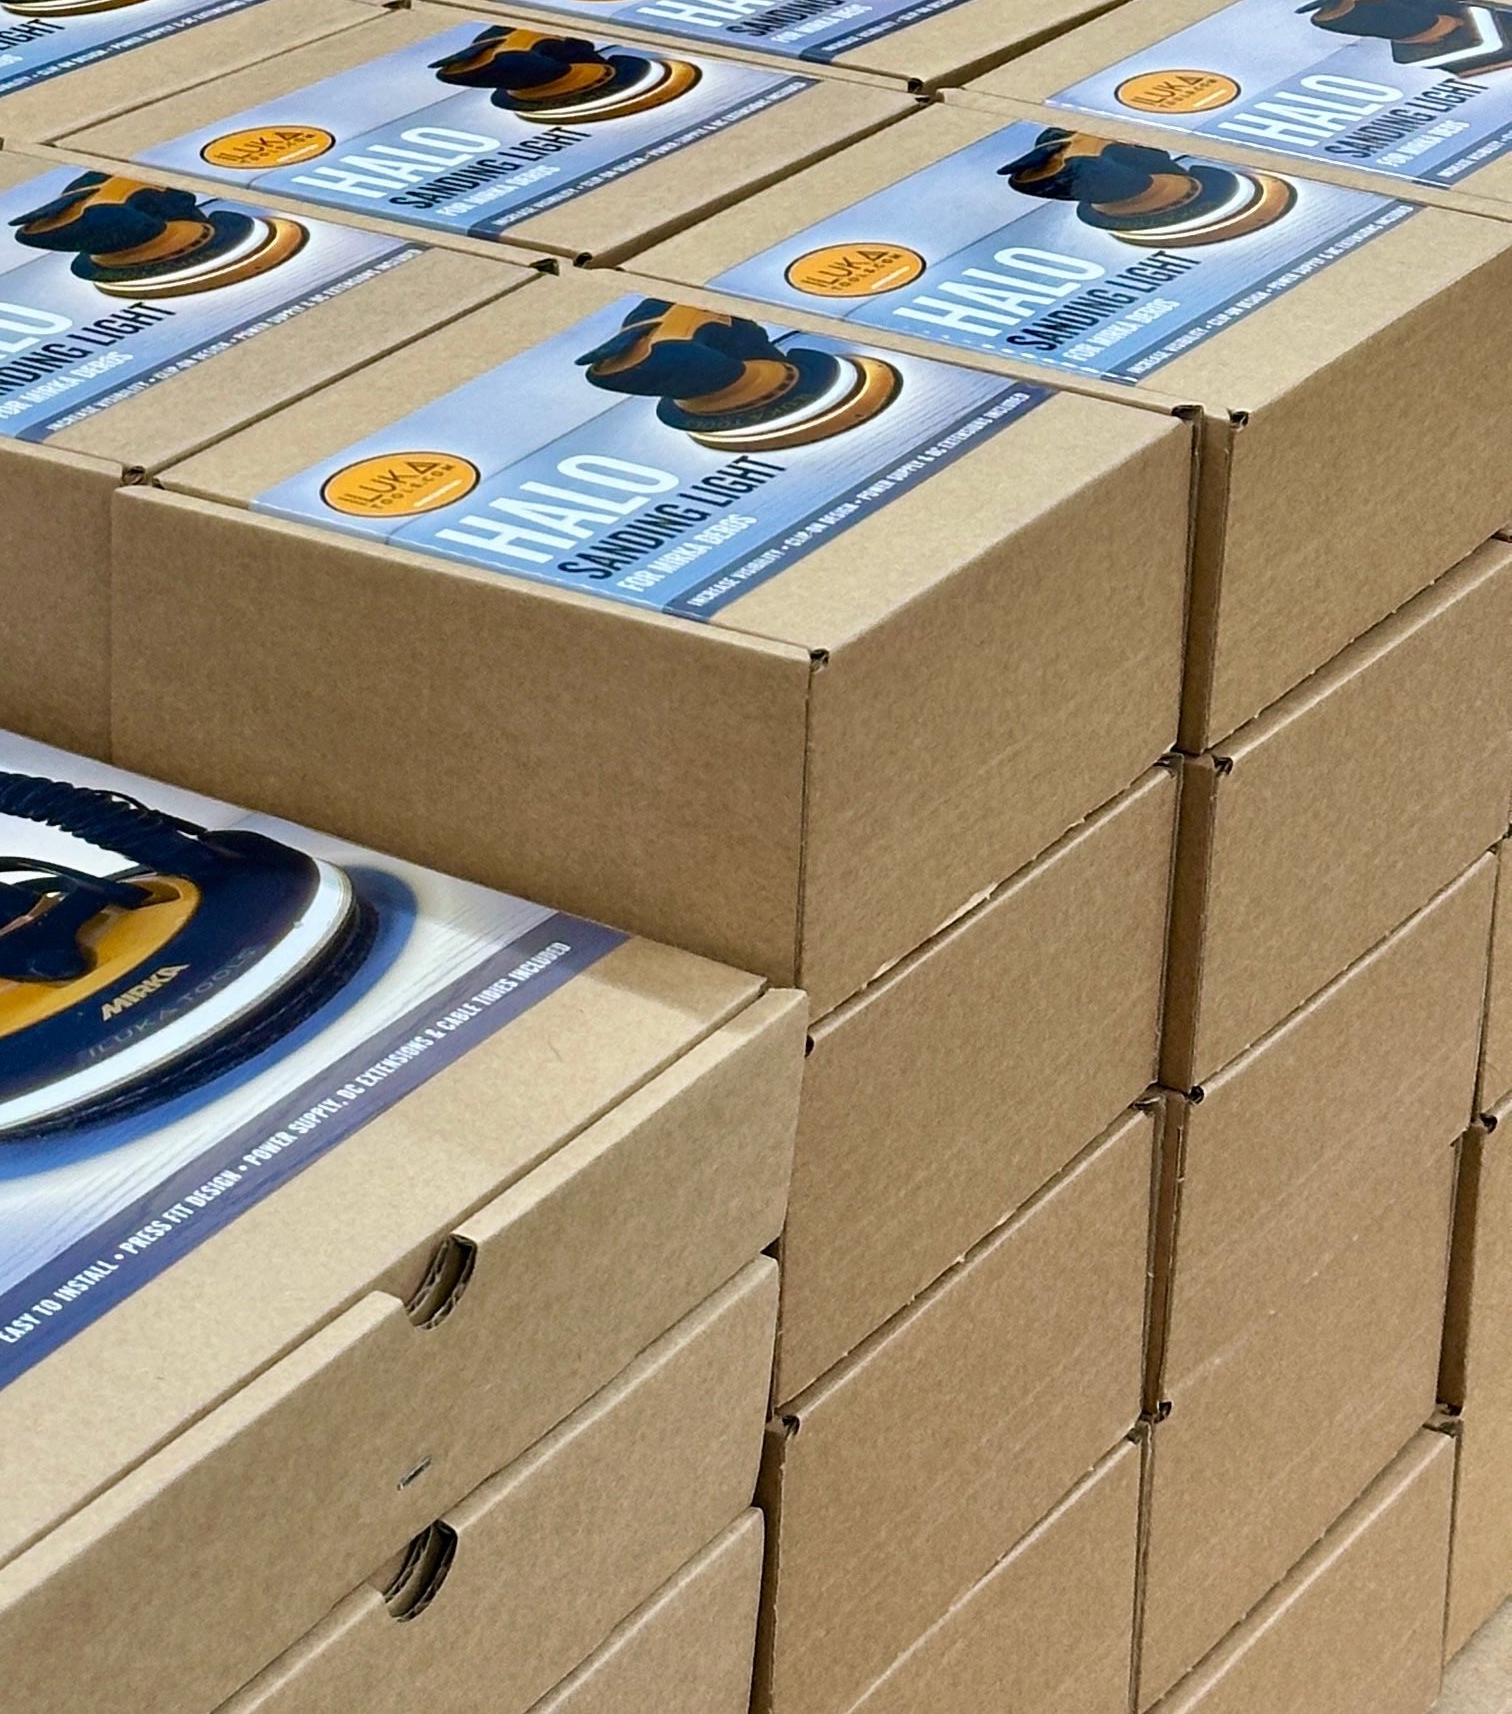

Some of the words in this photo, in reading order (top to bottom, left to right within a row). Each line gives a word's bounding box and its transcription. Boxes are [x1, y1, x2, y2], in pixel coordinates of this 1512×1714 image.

[1131, 75, 1203, 106] ILUKA
[1218, 74, 1404, 147] HALO
[1325, 108, 1437, 159] SANDING
[1412, 78, 1490, 119] LIGHT
[214, 131, 303, 164] ILUKA
[291, 125, 501, 198] HALO
[389, 158, 521, 209] SANDING
[500, 127, 593, 163] LIGHT
[801, 249, 892, 290] ILUKA
[893, 246, 1106, 337] HALO
[1006, 284, 1138, 352] SANDING
[1104, 250, 1202, 296] LIGHT
[66, 302, 176, 348] LIGHT
[1062, 344, 1104, 361] FOR
[338, 460, 442, 507] ILUKA
[435, 454, 679, 564] HALO
[557, 502, 711, 580] SANDING
[689, 455, 786, 519] LIGHT
[617, 565, 663, 592] FOR
[653, 539, 712, 576] MIRKA
[101, 963, 190, 1021] MIRKA
[33, 1299, 62, 1316] TO
[53, 1260, 119, 1302] INSTALL
[120, 1221, 172, 1255] PRESS
[162, 1204, 193, 1227] FIT
[185, 1170, 241, 1208] DESIGN
[243, 1132, 298, 1166] POWER
[337, 1082, 366, 1100] DC
[356, 1036, 434, 1087] EXTENSIONS
[425, 1029, 446, 1040] &
[436, 1003, 482, 1032] CABLE
[472, 978, 519, 1006] TIDIES
[508, 942, 572, 981] INCLUDED
